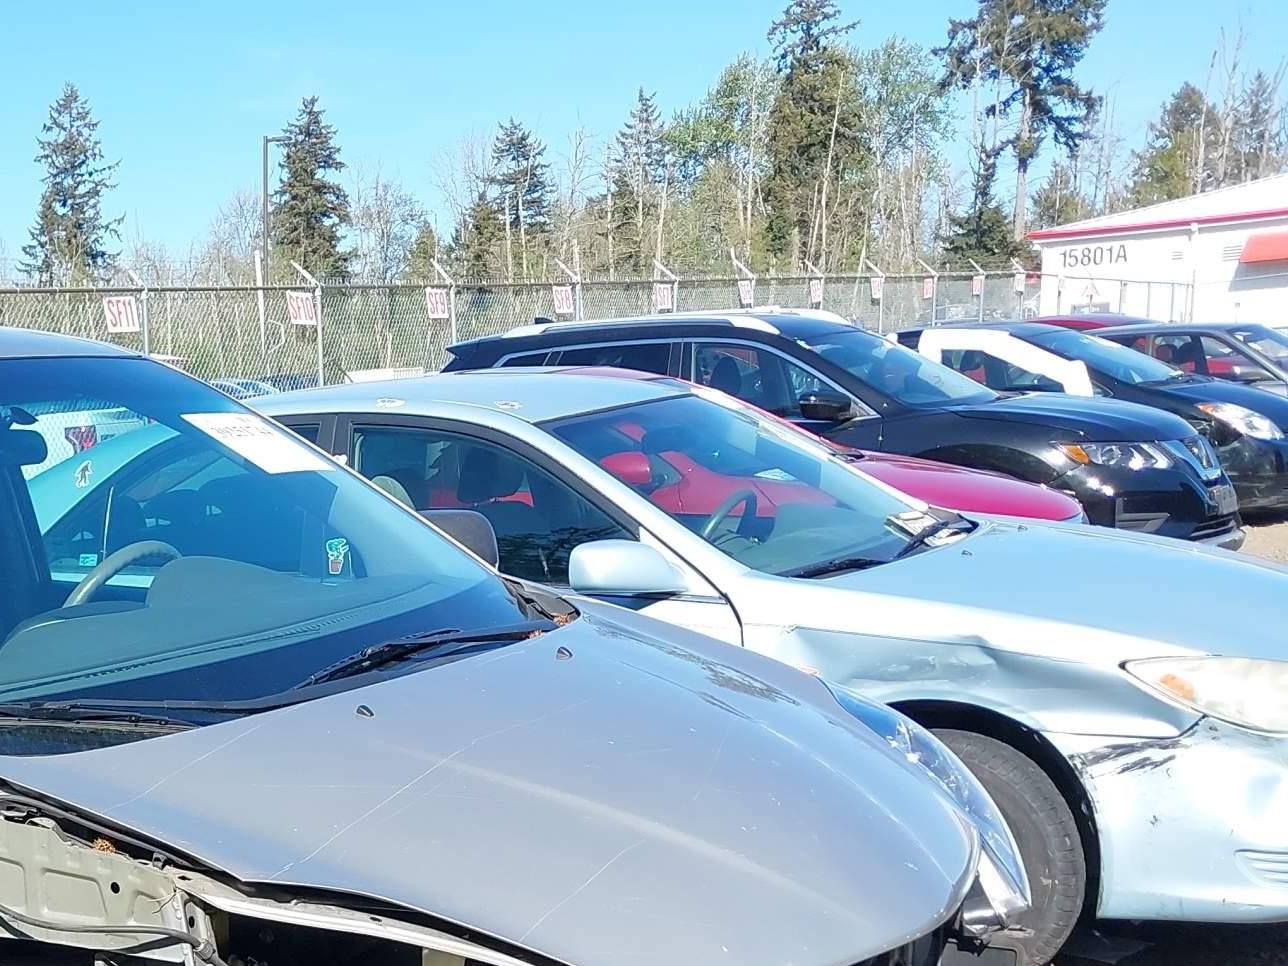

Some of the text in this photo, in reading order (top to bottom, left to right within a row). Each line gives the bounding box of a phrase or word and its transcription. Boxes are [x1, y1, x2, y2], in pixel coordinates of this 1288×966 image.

[1059, 244, 1128, 269] 15801A
[107, 299, 136, 327] SF11
[288, 295, 314, 321] SF10
[428, 291, 446, 314] SF9
